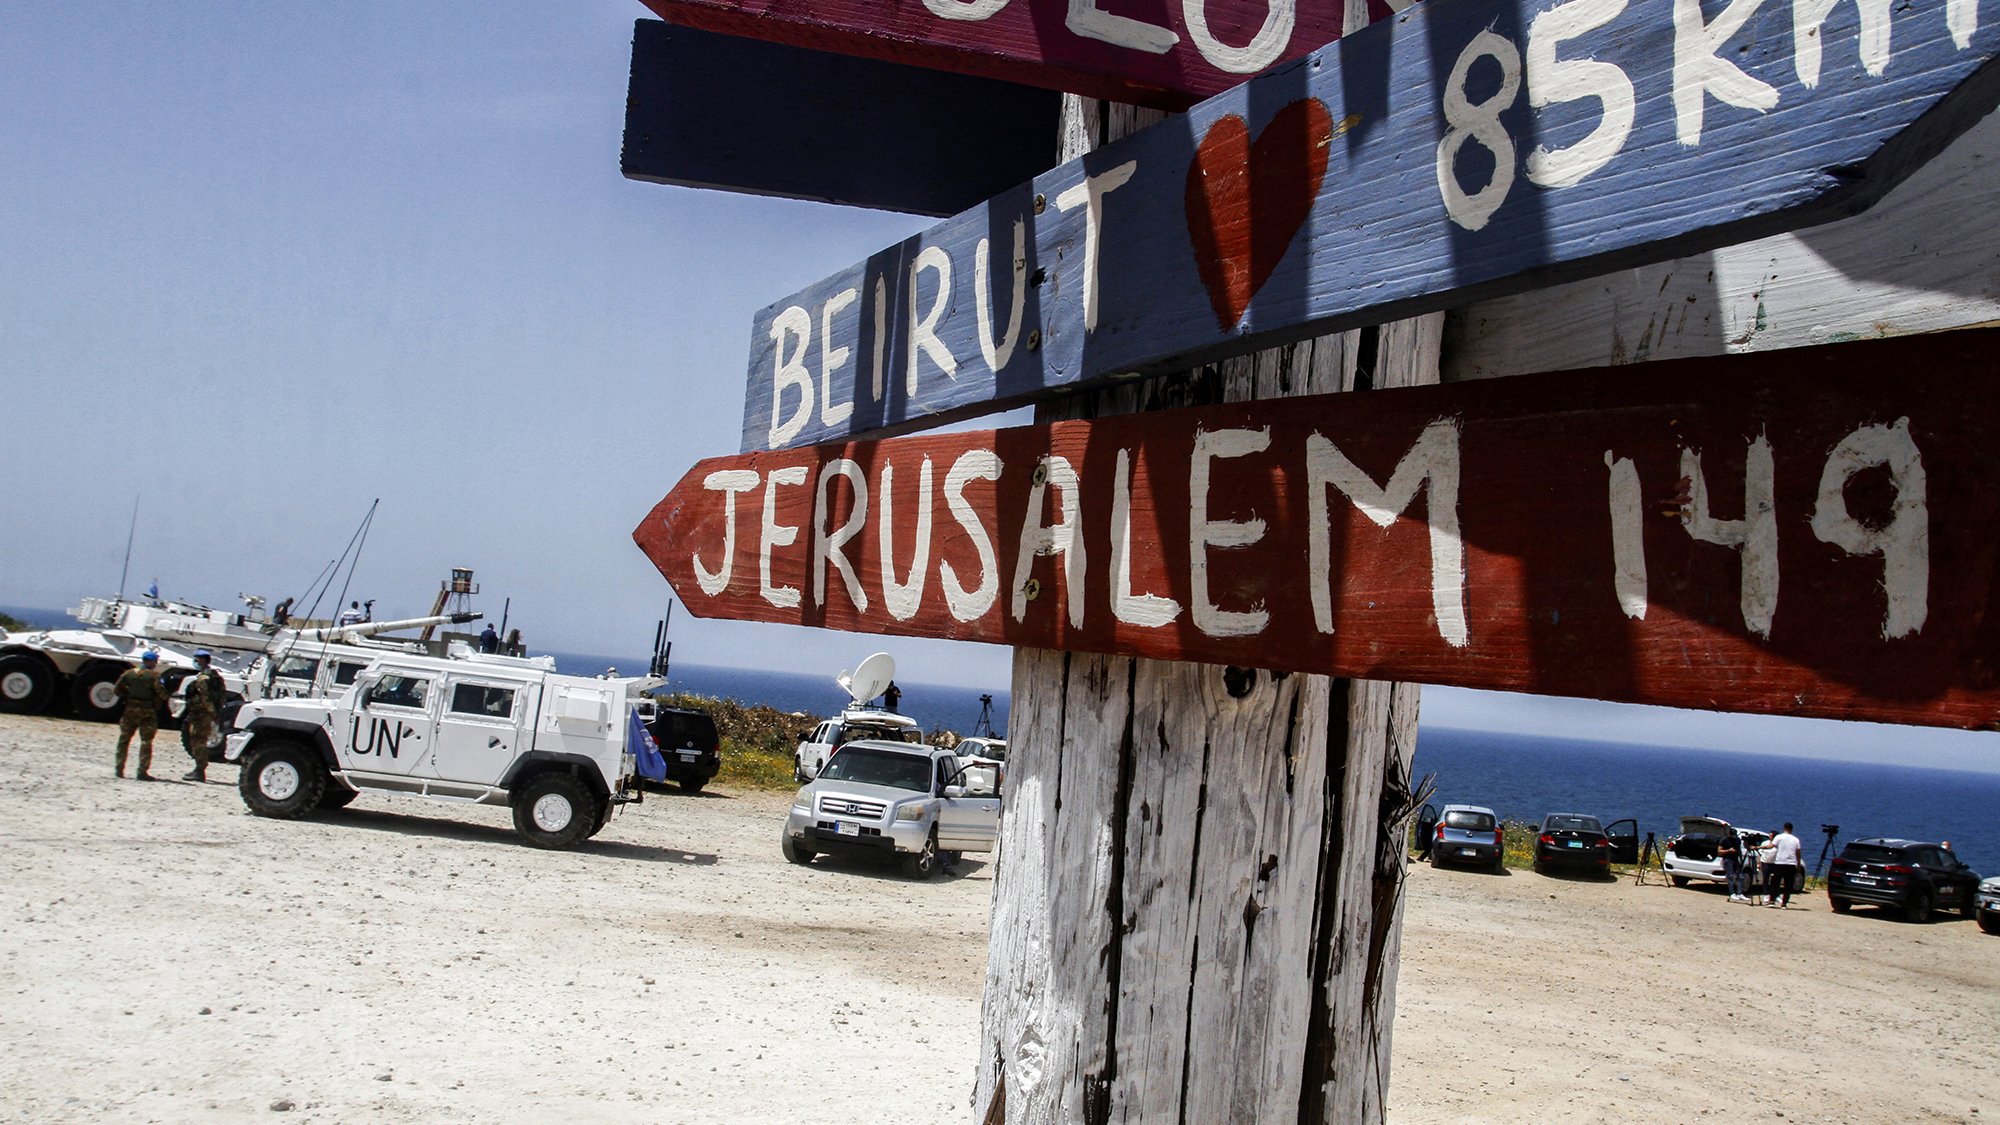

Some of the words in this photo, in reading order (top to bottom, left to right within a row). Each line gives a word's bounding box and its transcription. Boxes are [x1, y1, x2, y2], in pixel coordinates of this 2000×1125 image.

[768, 159, 1137, 450] BEIRUT
[692, 411, 1470, 648] JERUSALEM
[1603, 415, 1929, 642] 149
[351, 715, 402, 759] UN
